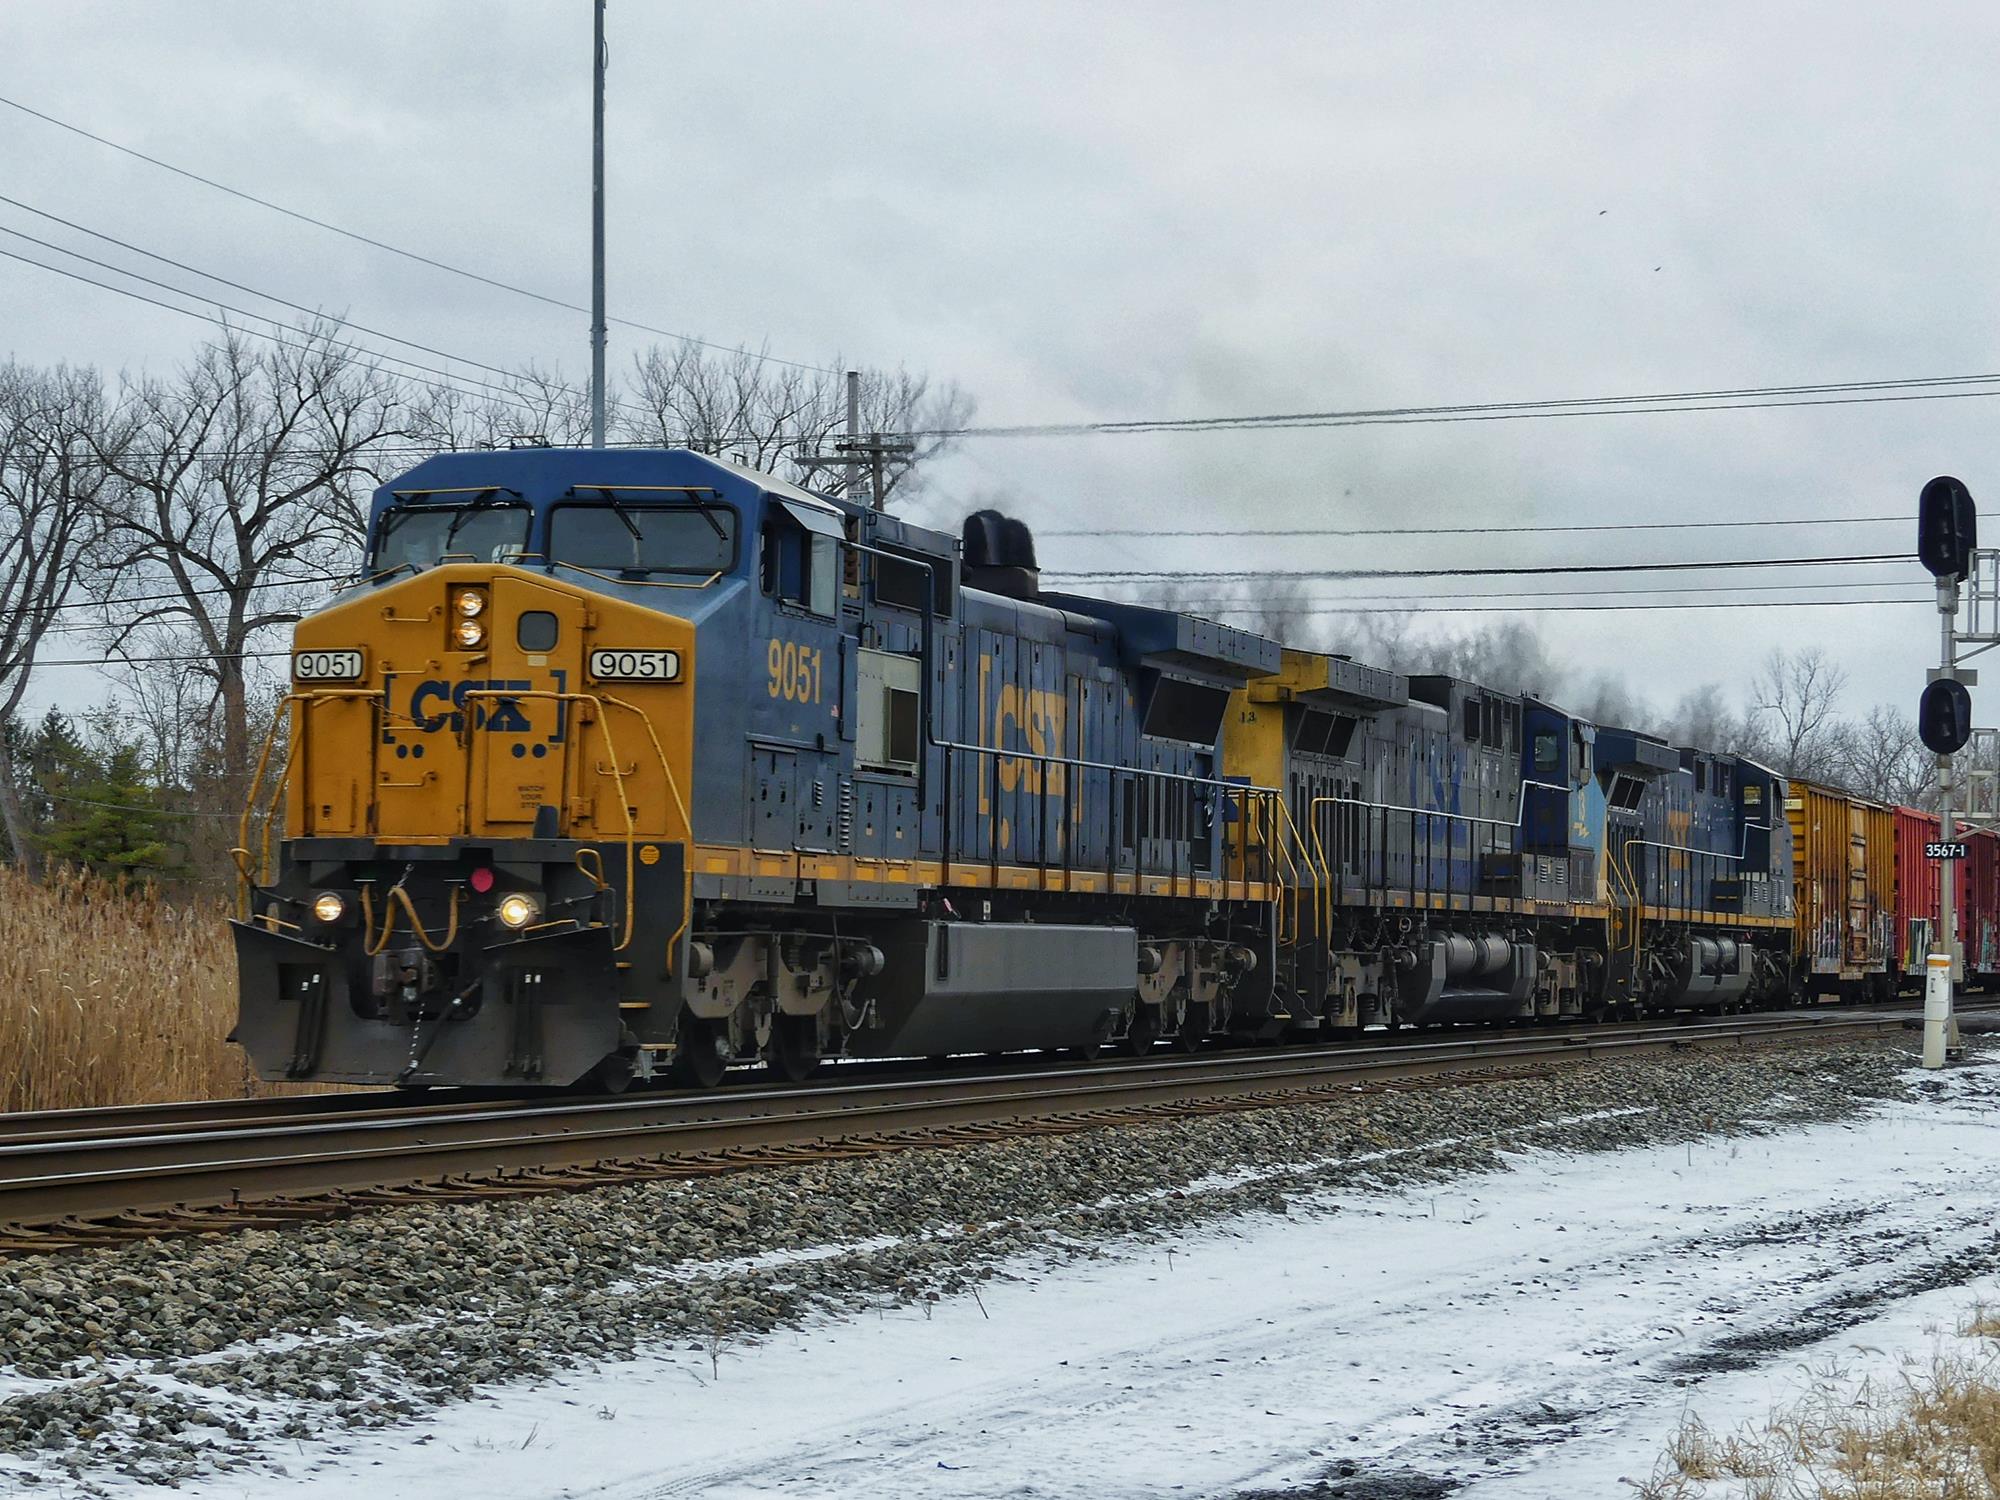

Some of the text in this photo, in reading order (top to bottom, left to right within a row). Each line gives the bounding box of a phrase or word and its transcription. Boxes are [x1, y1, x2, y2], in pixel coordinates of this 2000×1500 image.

[301, 654, 355, 677] 9051
[599, 653, 668, 677] 9051
[767, 638, 822, 704] 9051
[411, 680, 531, 732] CSX
[1926, 844, 1965, 857] 3567-1
